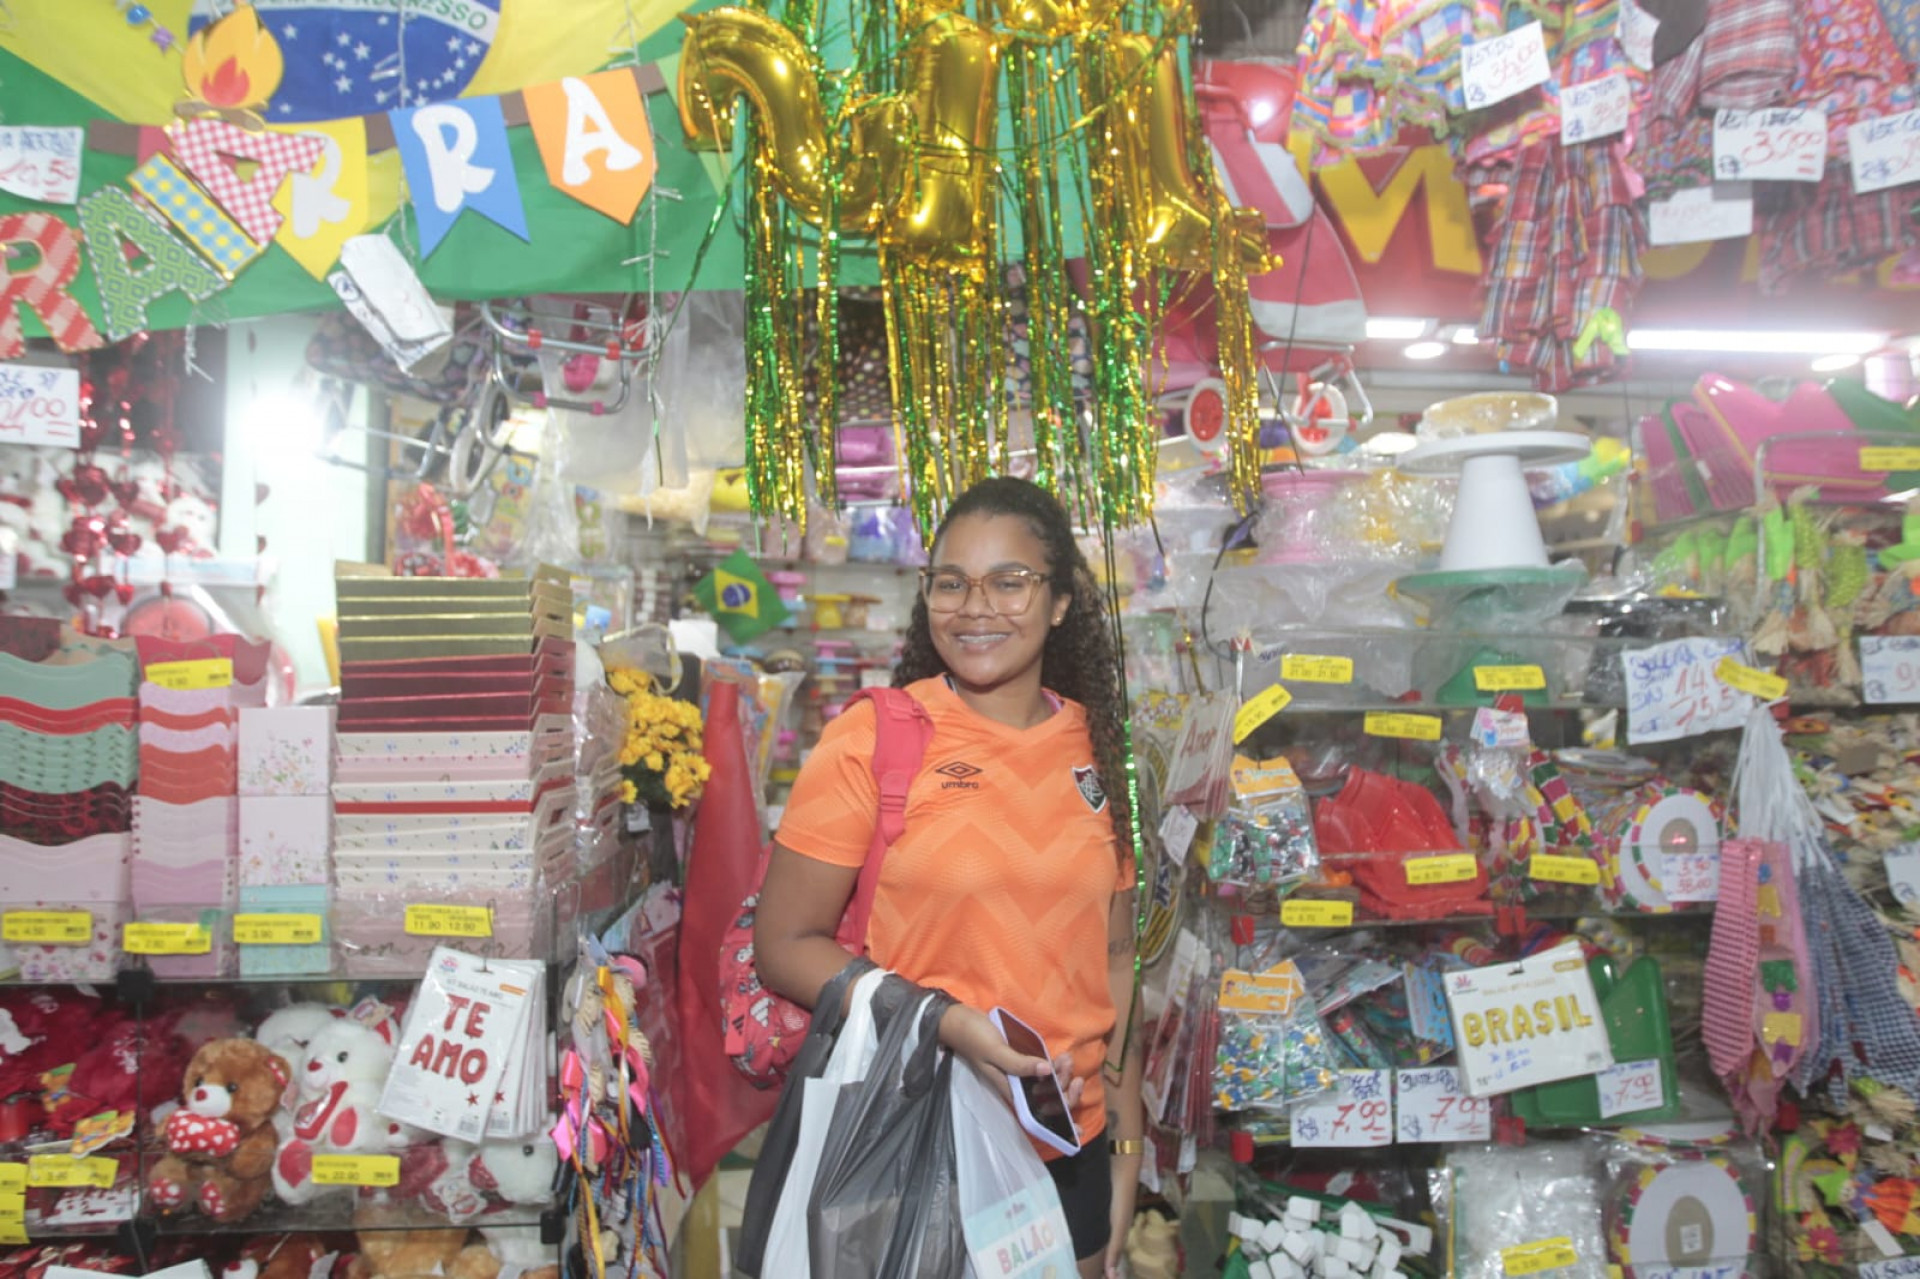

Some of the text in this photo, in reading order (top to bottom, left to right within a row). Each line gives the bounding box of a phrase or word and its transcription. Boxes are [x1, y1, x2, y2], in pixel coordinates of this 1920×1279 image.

[941, 780, 980, 790] umbro
[443, 992, 492, 1037] TE
[1462, 994, 1593, 1047] BRASIL
[408, 1033, 489, 1086] AMO
